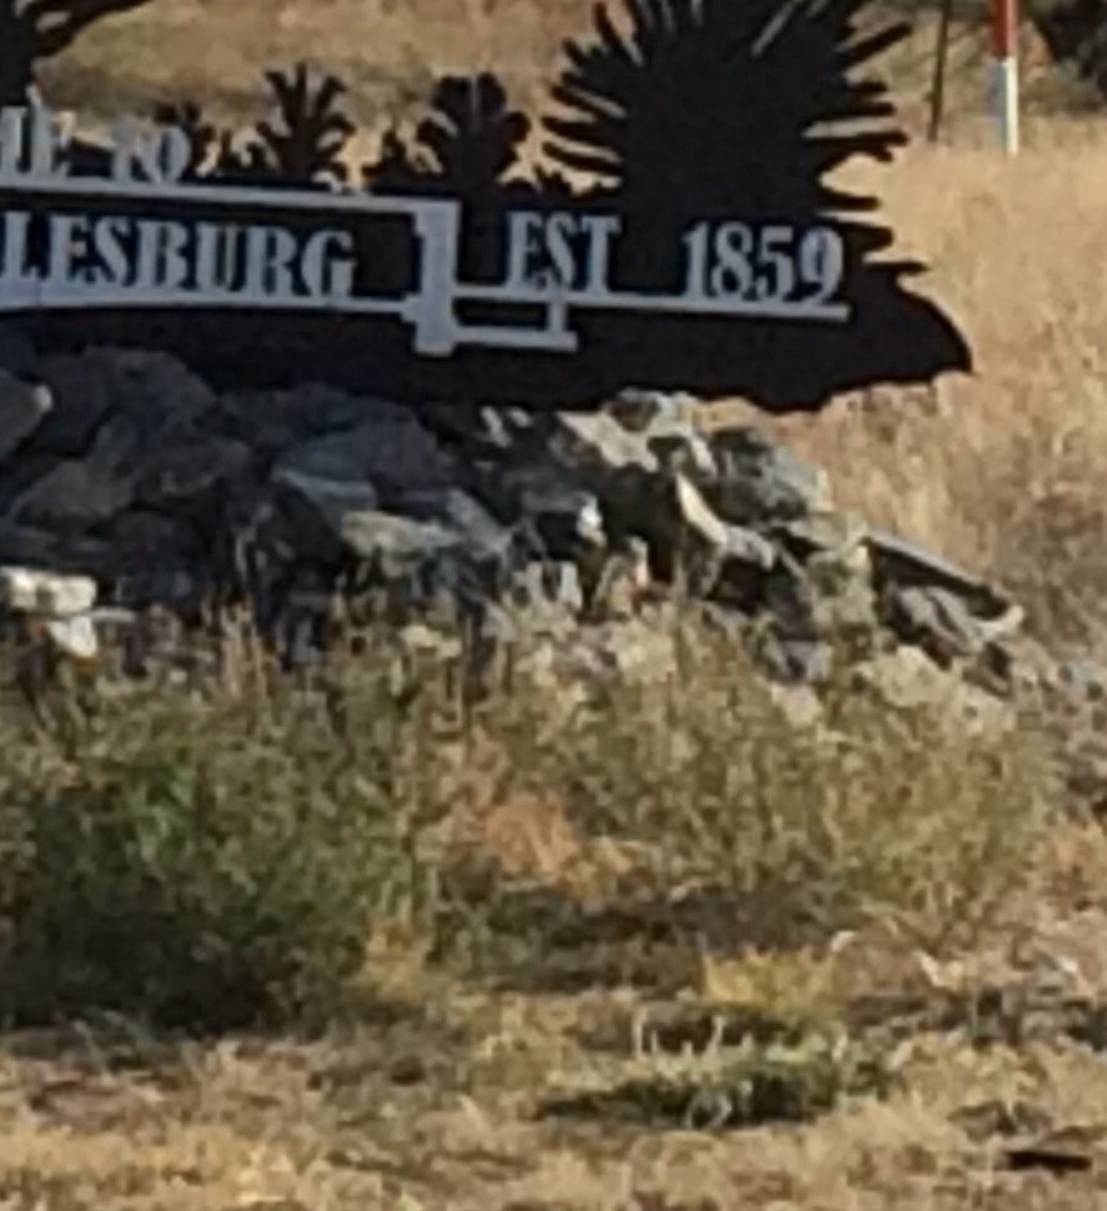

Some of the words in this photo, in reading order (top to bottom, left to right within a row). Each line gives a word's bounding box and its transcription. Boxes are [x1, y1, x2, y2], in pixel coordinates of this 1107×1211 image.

[109, 112, 191, 185] TO
[507, 211, 621, 298] EST
[681, 222, 845, 303] 1859
